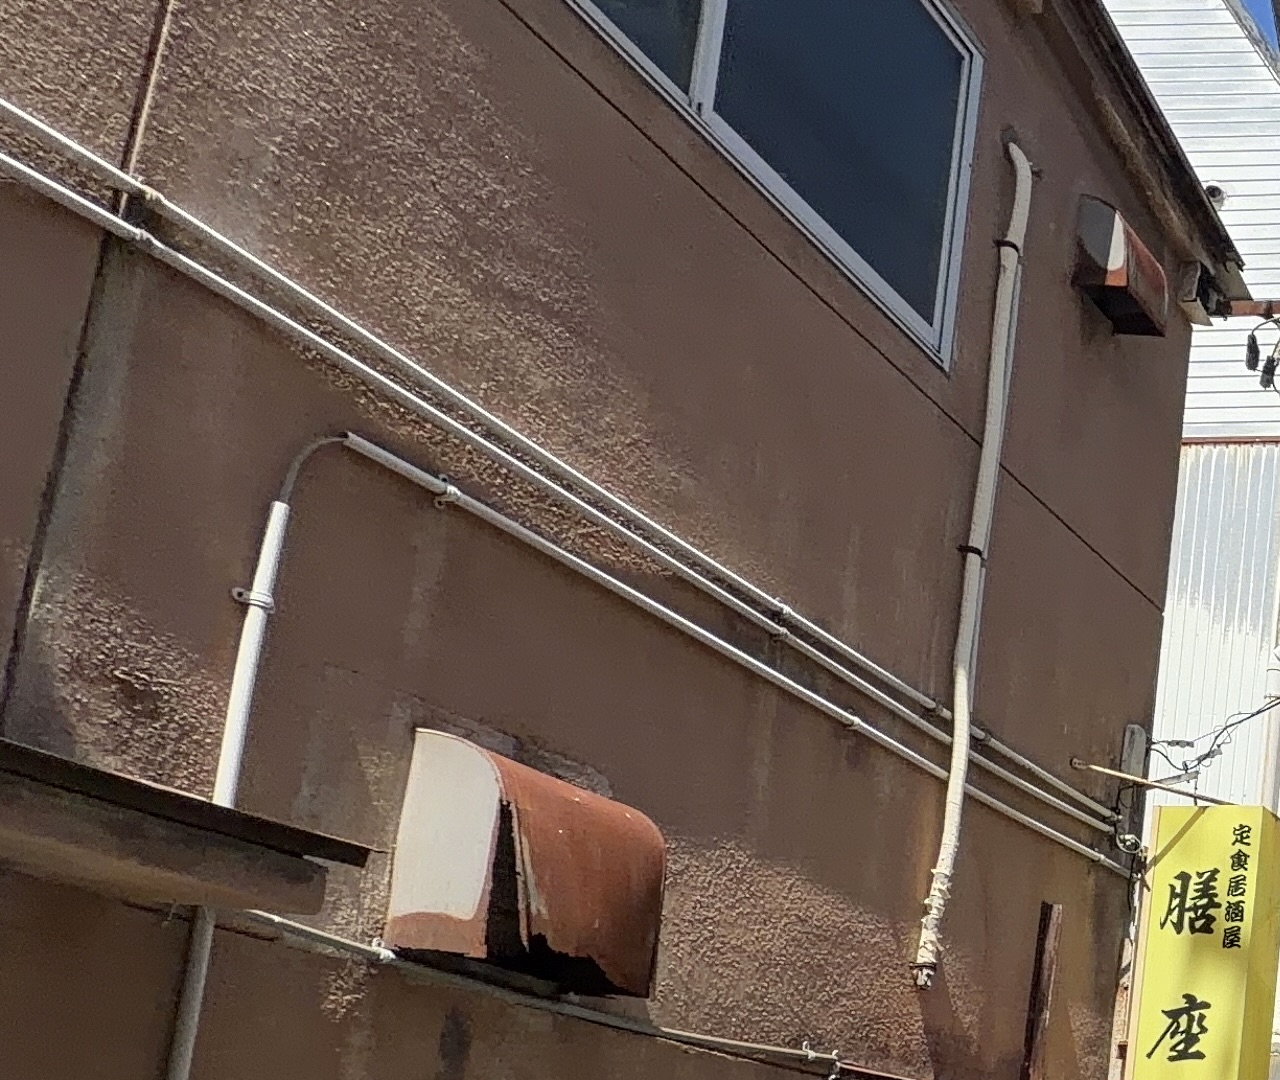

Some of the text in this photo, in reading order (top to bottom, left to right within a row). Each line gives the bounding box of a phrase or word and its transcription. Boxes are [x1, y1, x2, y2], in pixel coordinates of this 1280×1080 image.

[1146, 867, 1222, 1063] 膳座
[1222, 823, 1252, 949] 定食居酒屋
